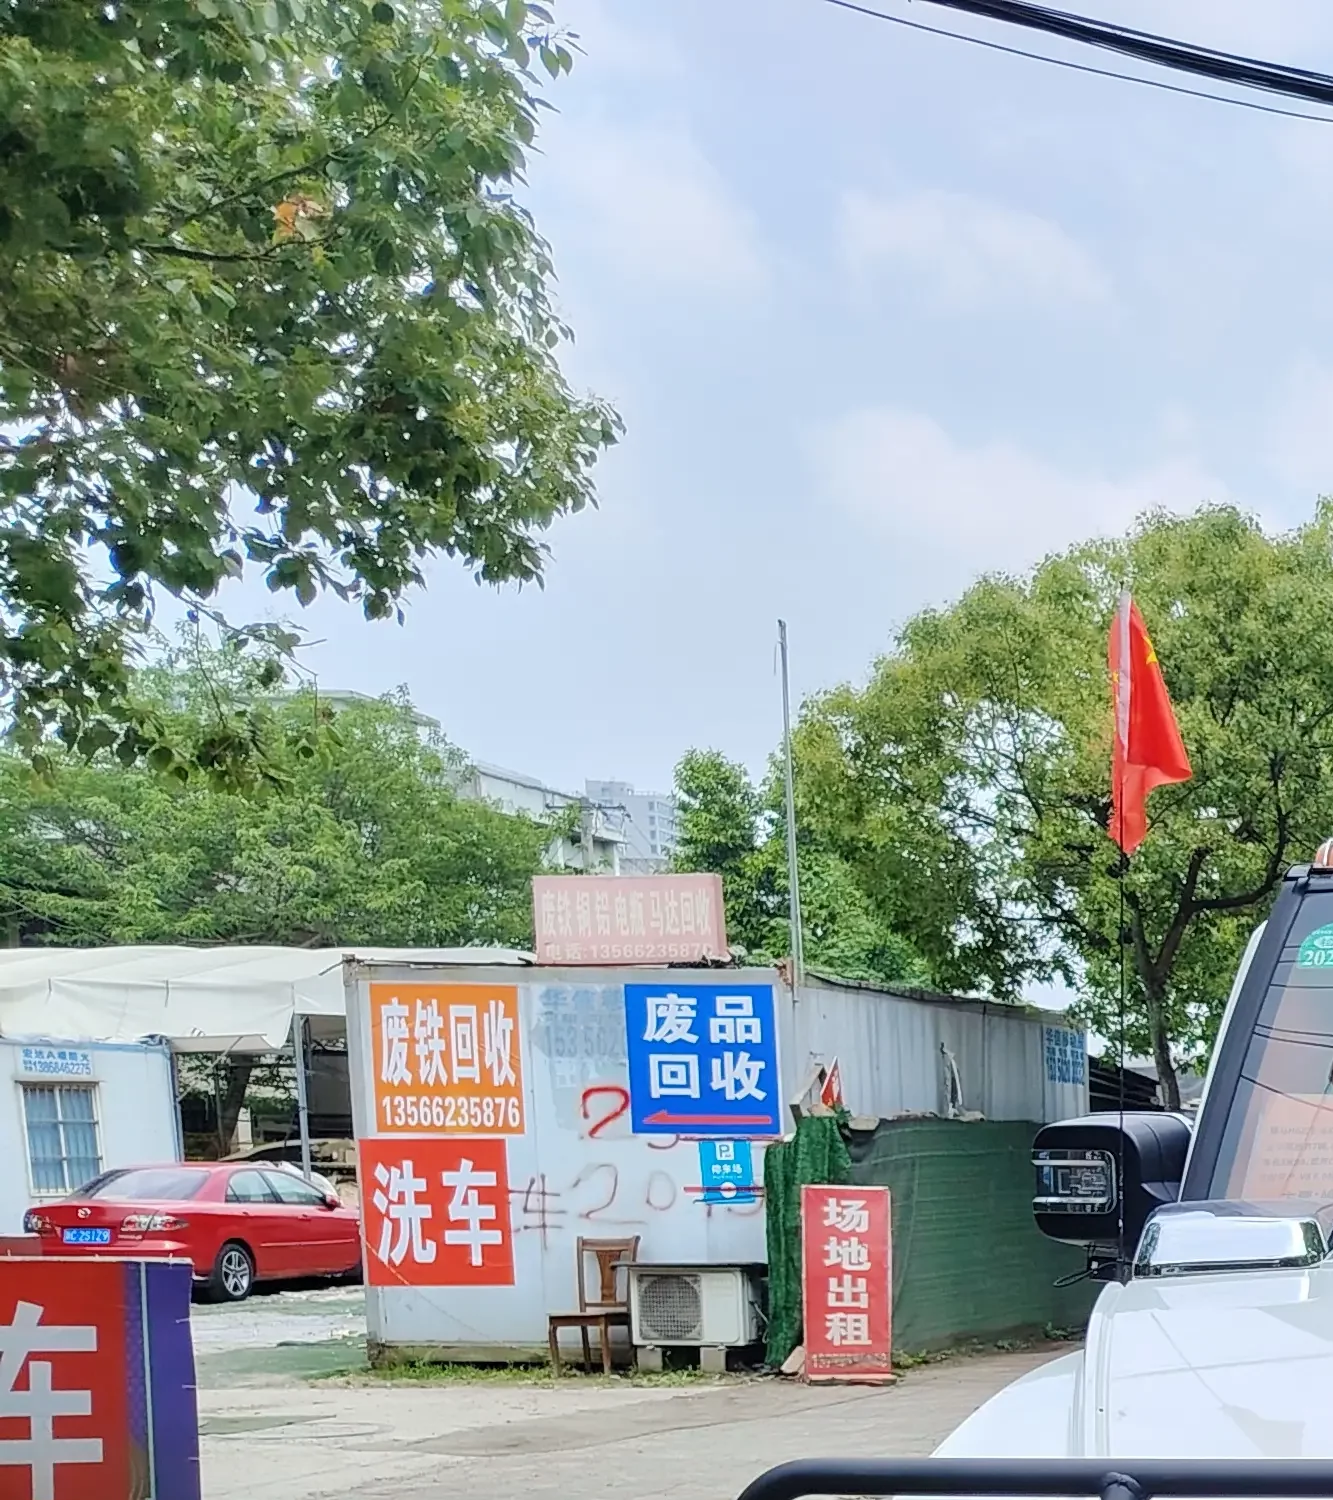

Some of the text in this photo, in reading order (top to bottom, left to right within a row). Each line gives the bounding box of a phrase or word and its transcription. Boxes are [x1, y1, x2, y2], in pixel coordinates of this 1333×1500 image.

[380, 996, 516, 1087] 废铁回收
[642, 993, 763, 1044] 废品
[381, 1095, 521, 1128] 13566235876
[648, 1051, 768, 1101] 回收
[373, 1158, 503, 1266] 洗车
[823, 1197, 872, 1346] 场地出租
